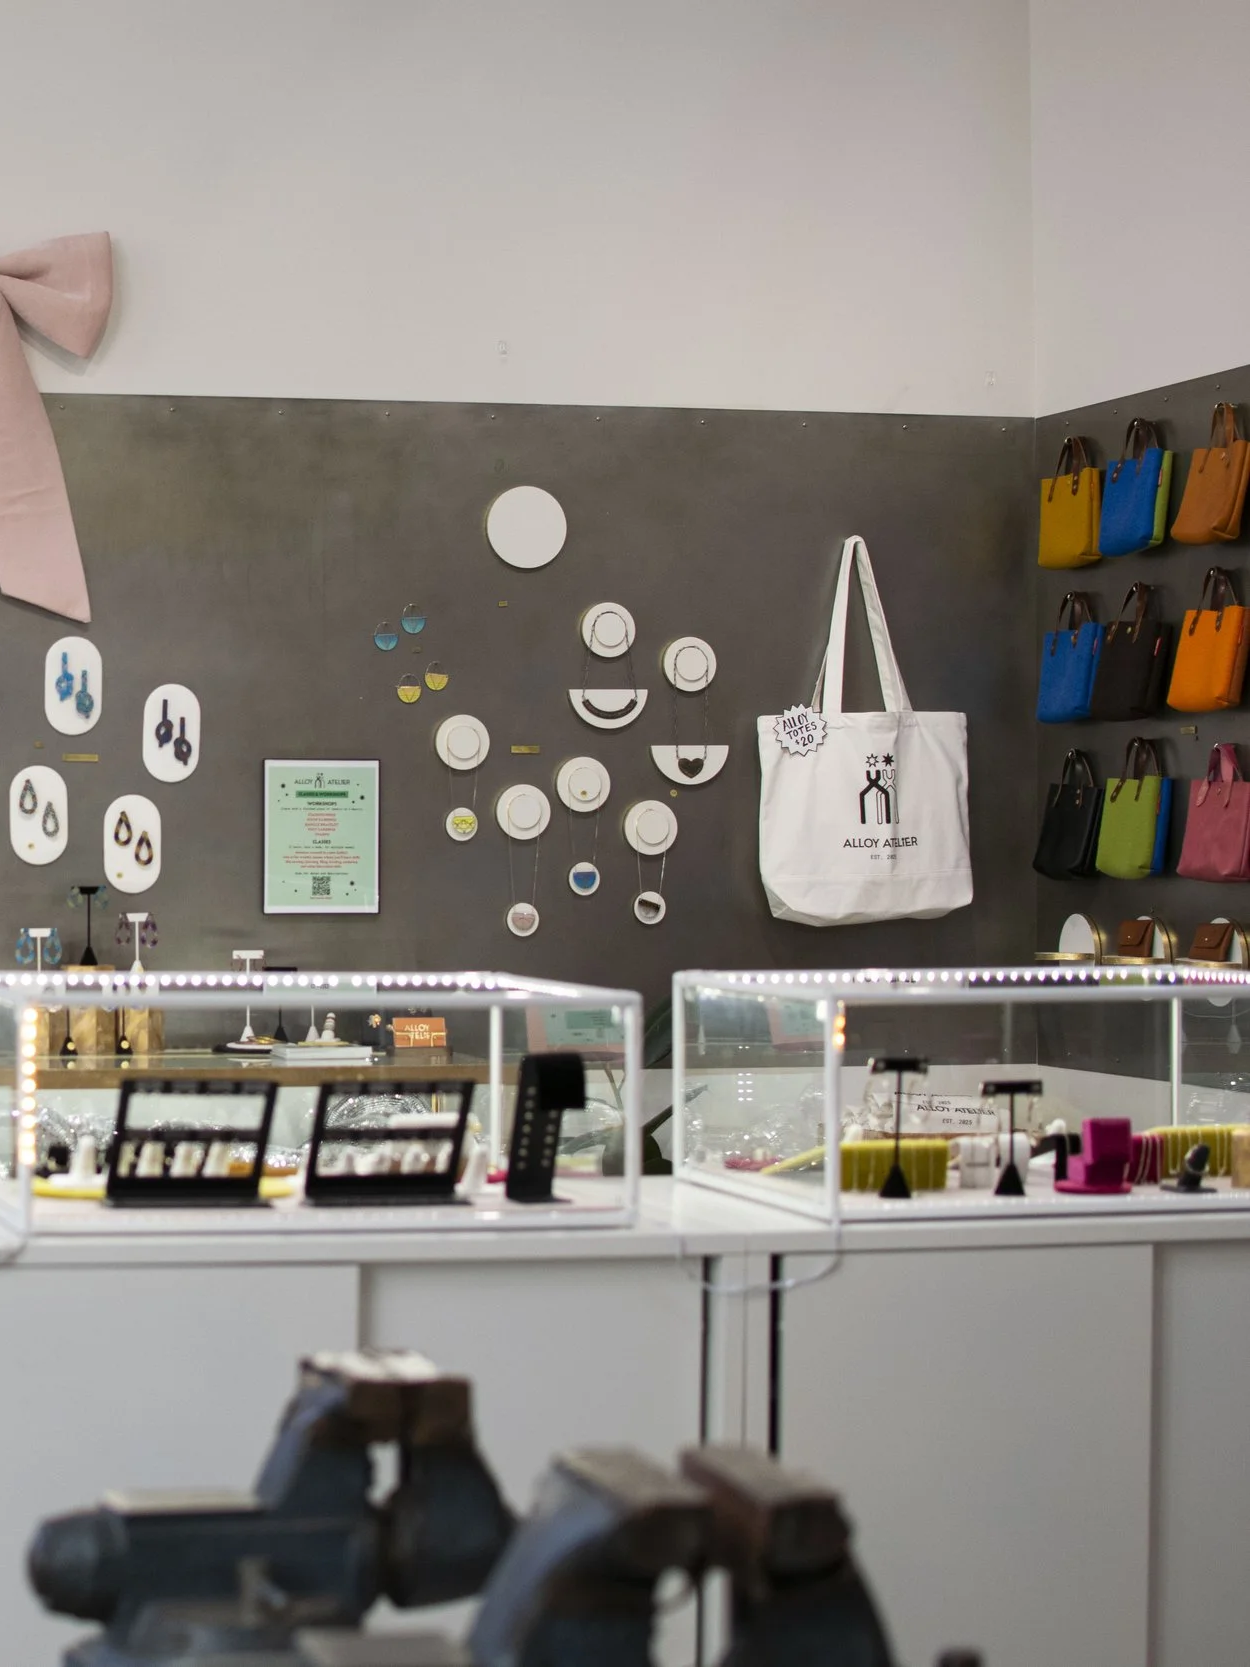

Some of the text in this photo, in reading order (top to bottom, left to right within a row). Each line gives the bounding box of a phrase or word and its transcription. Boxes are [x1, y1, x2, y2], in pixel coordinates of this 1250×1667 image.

[782, 711, 808, 731] ALLOY
[786, 721, 817, 740] TOTES
[843, 836, 918, 848] ALLOY ATELIER
[404, 1023, 430, 1032] ALLOY
[916, 1104, 950, 1112] ALLOY
